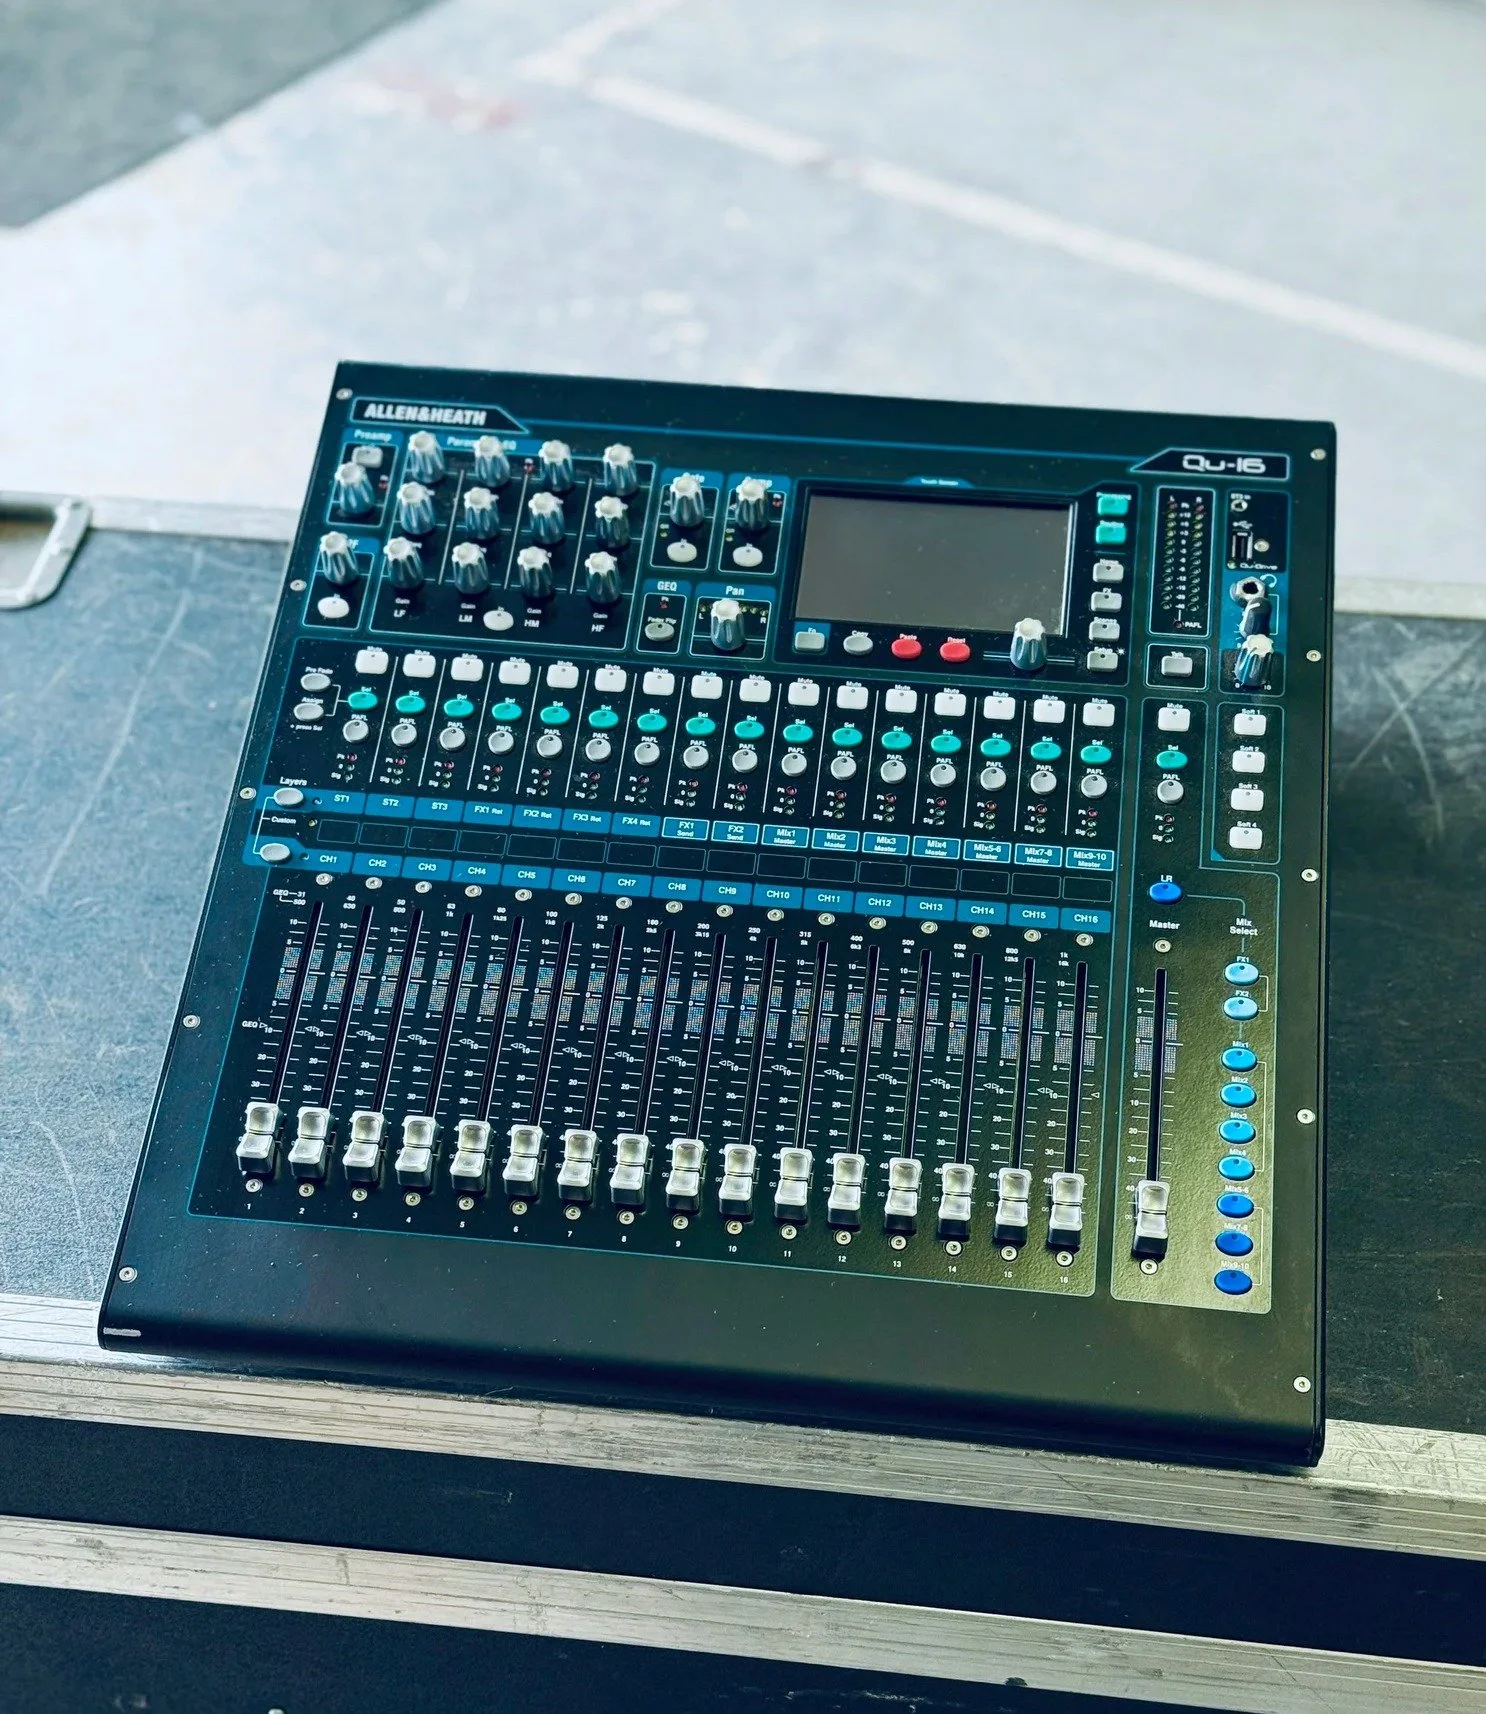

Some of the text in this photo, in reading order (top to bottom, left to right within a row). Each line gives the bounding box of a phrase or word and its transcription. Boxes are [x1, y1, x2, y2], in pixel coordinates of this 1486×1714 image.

[364, 403, 486, 425] ALLEN&HEATH
[1183, 454, 1266, 473] Qu-16
[658, 581, 677, 591] GEQ
[726, 586, 744, 596] Pan
[592, 624, 604, 632] HF
[1163, 773, 1180, 781] PAFL
[280, 777, 307, 786] Layers
[334, 794, 349, 802] ST1
[382, 798, 399, 806] ST2
[432, 802, 448, 810] ST3
[271, 816, 296, 824] Custom
[573, 813, 588, 821] FX3
[777, 829, 795, 837] Mix1
[927, 840, 946, 848] Mix4
[974, 844, 1001, 852] Mix5-6
[1025, 848, 1052, 856] Mix7-8
[1073, 852, 1106, 860] Mix9-10
[320, 855, 337, 863] CH1
[369, 859, 387, 867] CH2
[418, 863, 436, 871] CH3
[518, 871, 536, 879] CH5
[767, 890, 790, 899] CH10
[818, 894, 840, 902] CH11
[868, 898, 891, 906] CH12
[920, 902, 942, 910] CH13
[971, 906, 994, 914] CH14
[1022, 910, 1046, 919] CH15
[1074, 914, 1098, 923] CH16
[1150, 920, 1180, 930] Master
[1230, 927, 1258, 936] Select
[242, 1020, 257, 1028] GEQ
[1231, 1112, 1248, 1120] Mix3
